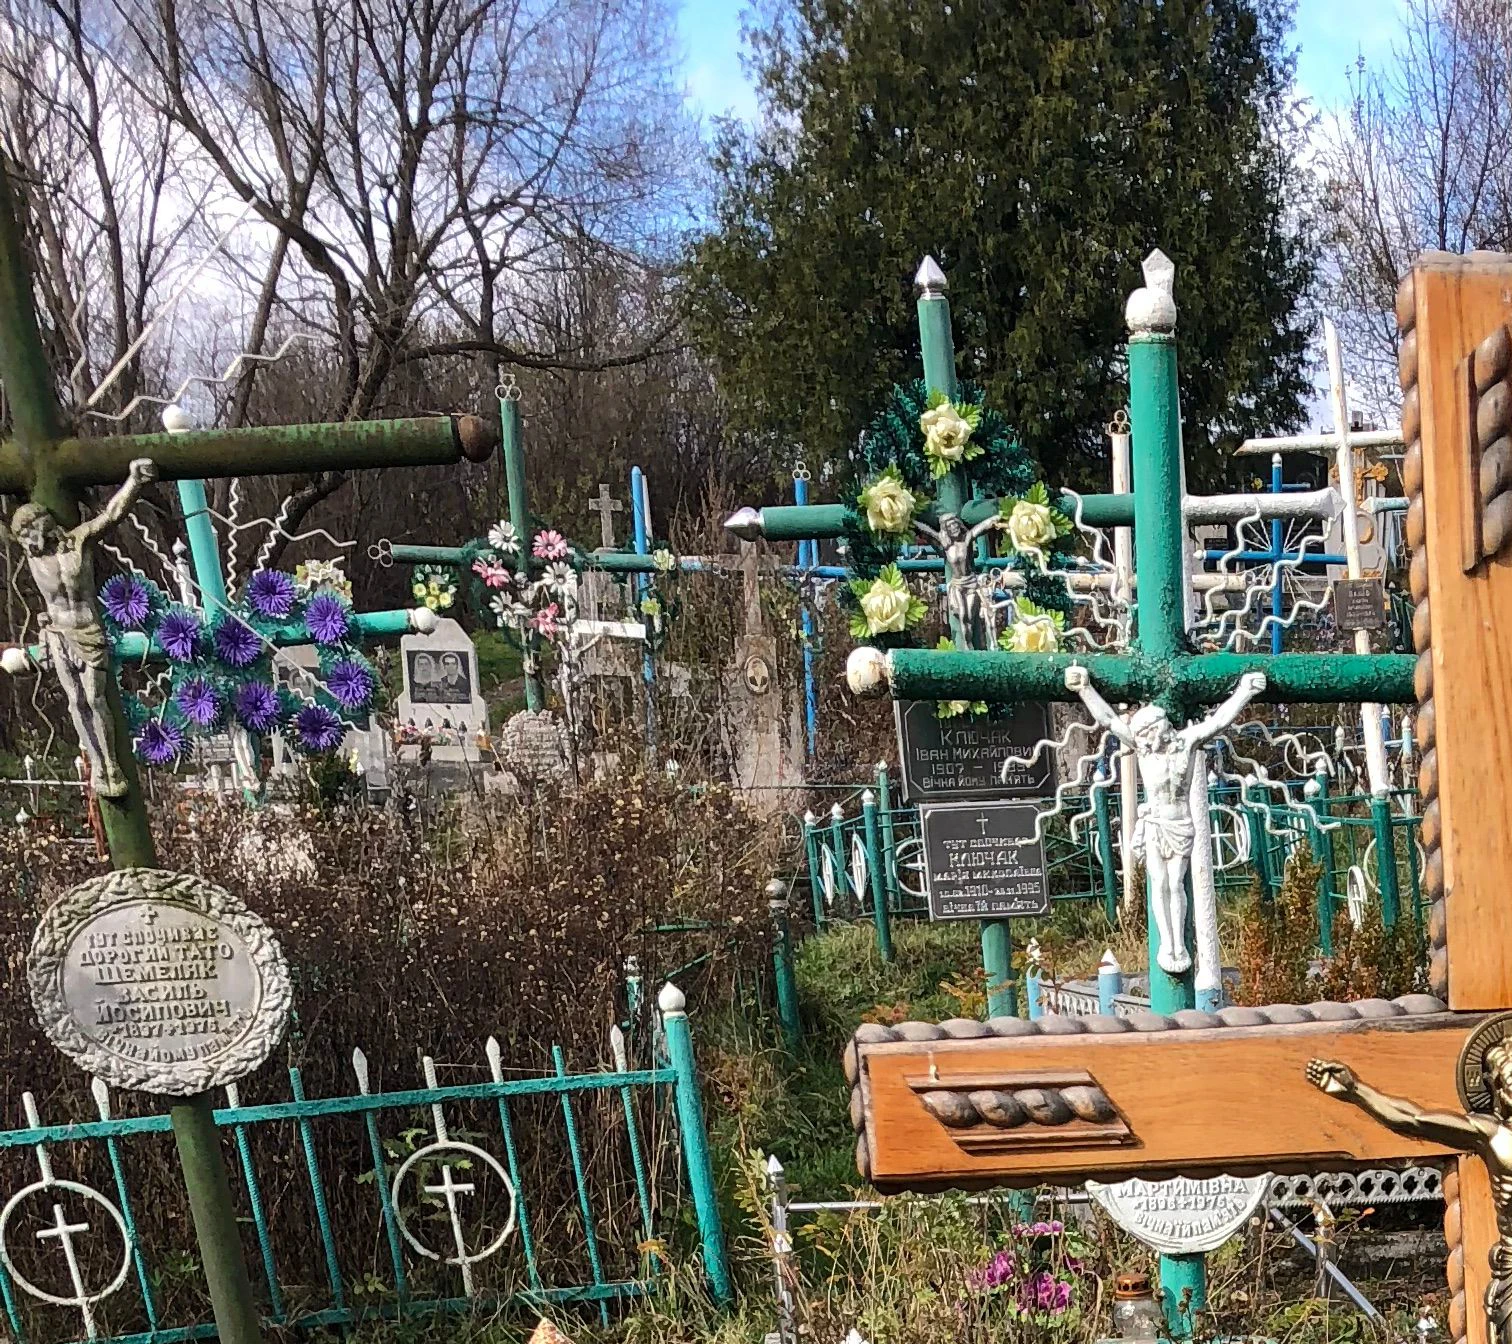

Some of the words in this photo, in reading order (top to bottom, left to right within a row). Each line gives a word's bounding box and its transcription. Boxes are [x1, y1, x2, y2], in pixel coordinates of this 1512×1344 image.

[940, 729, 1012, 746] КЛЮЧАК
[916, 748, 949, 761] ІВАН
[932, 763, 965, 775] 1907
[922, 776, 956, 789] ВІЧНА
[942, 838, 968, 850] ТУТ
[949, 849, 1019, 868] КЛЮЧАК
[174, 942, 235, 962] ТАТО
[117, 982, 208, 1004] ВАСИЛЬ
